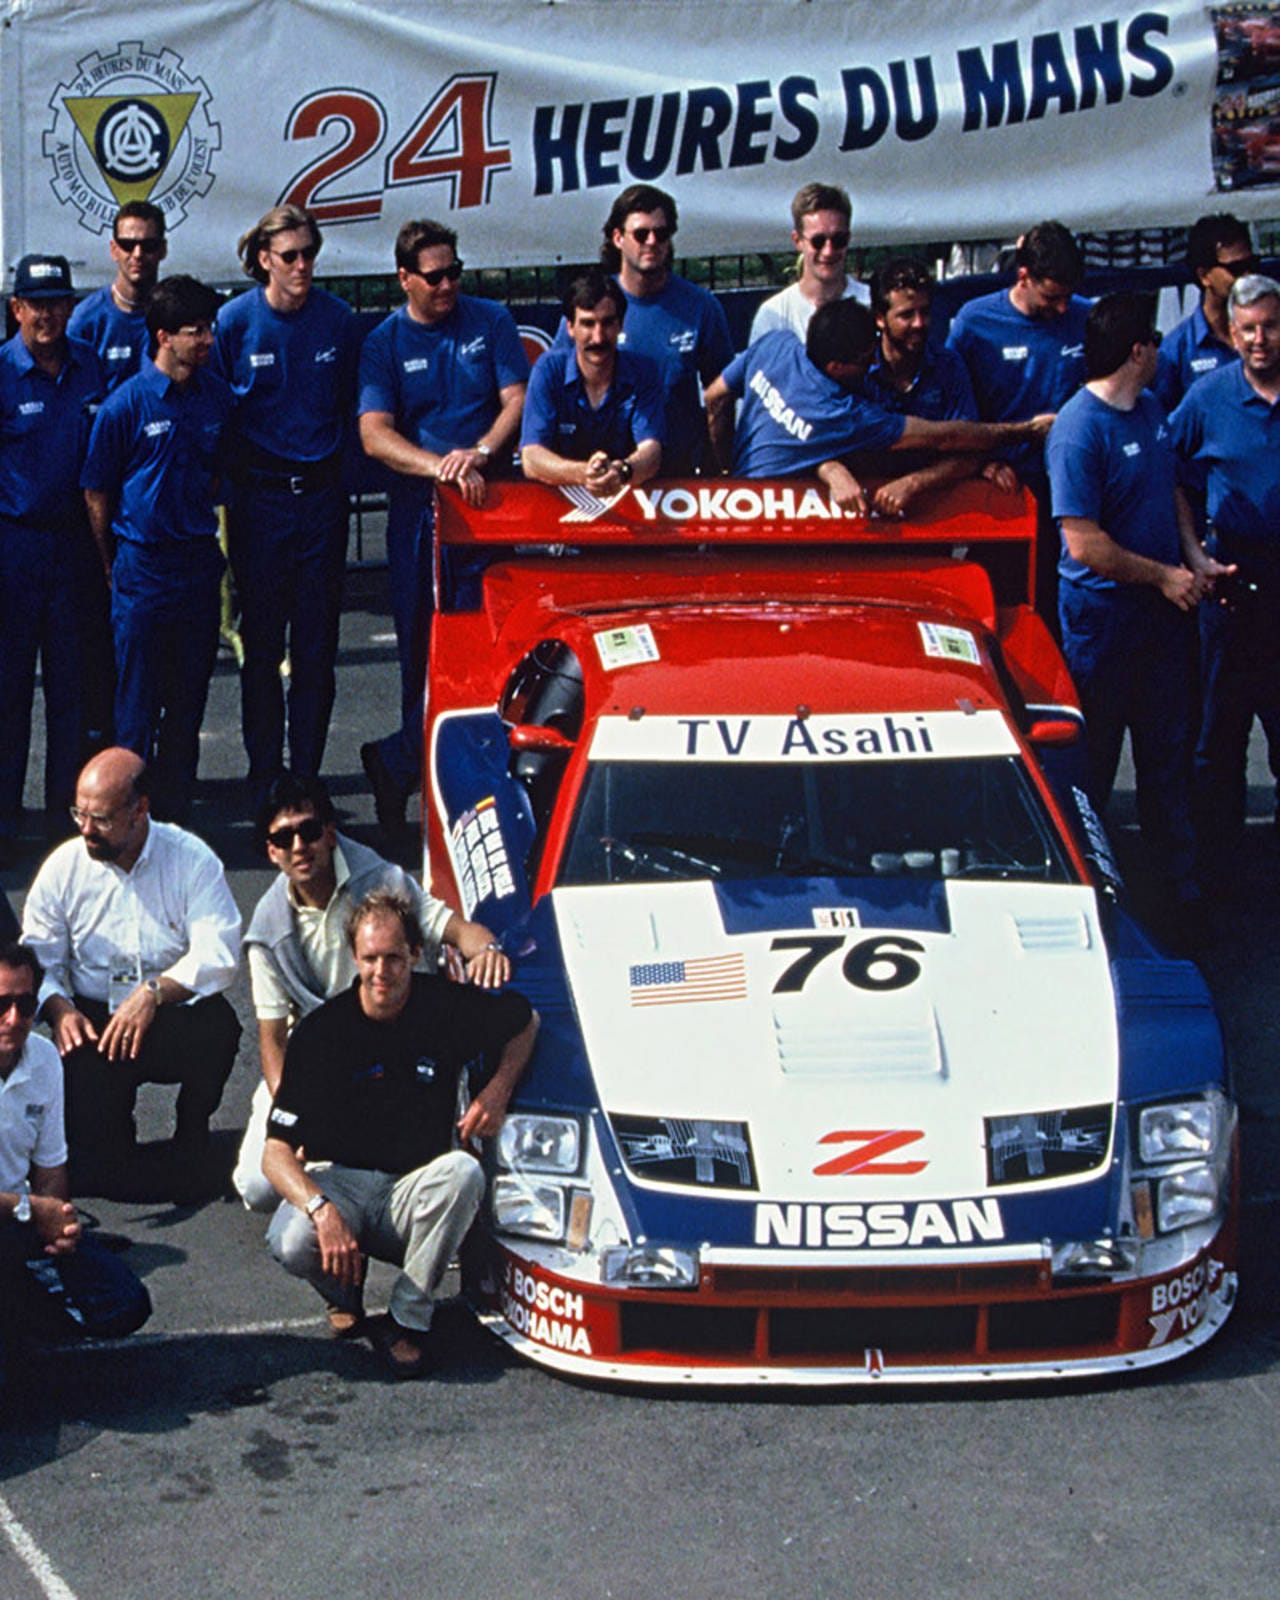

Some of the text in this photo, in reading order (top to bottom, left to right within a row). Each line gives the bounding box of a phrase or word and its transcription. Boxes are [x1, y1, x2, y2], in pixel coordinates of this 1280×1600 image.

[75, 57, 186, 96] 24 HEURES DU MANS
[277, 12, 1174, 225] 24 HEURES DU MANS
[749, 369, 812, 441] NISSAN
[677, 717, 933, 756] TV Asahi
[769, 935, 926, 994] 76
[754, 1199, 1005, 1247] NISSAN
[514, 1268, 583, 1321] BOSCH
